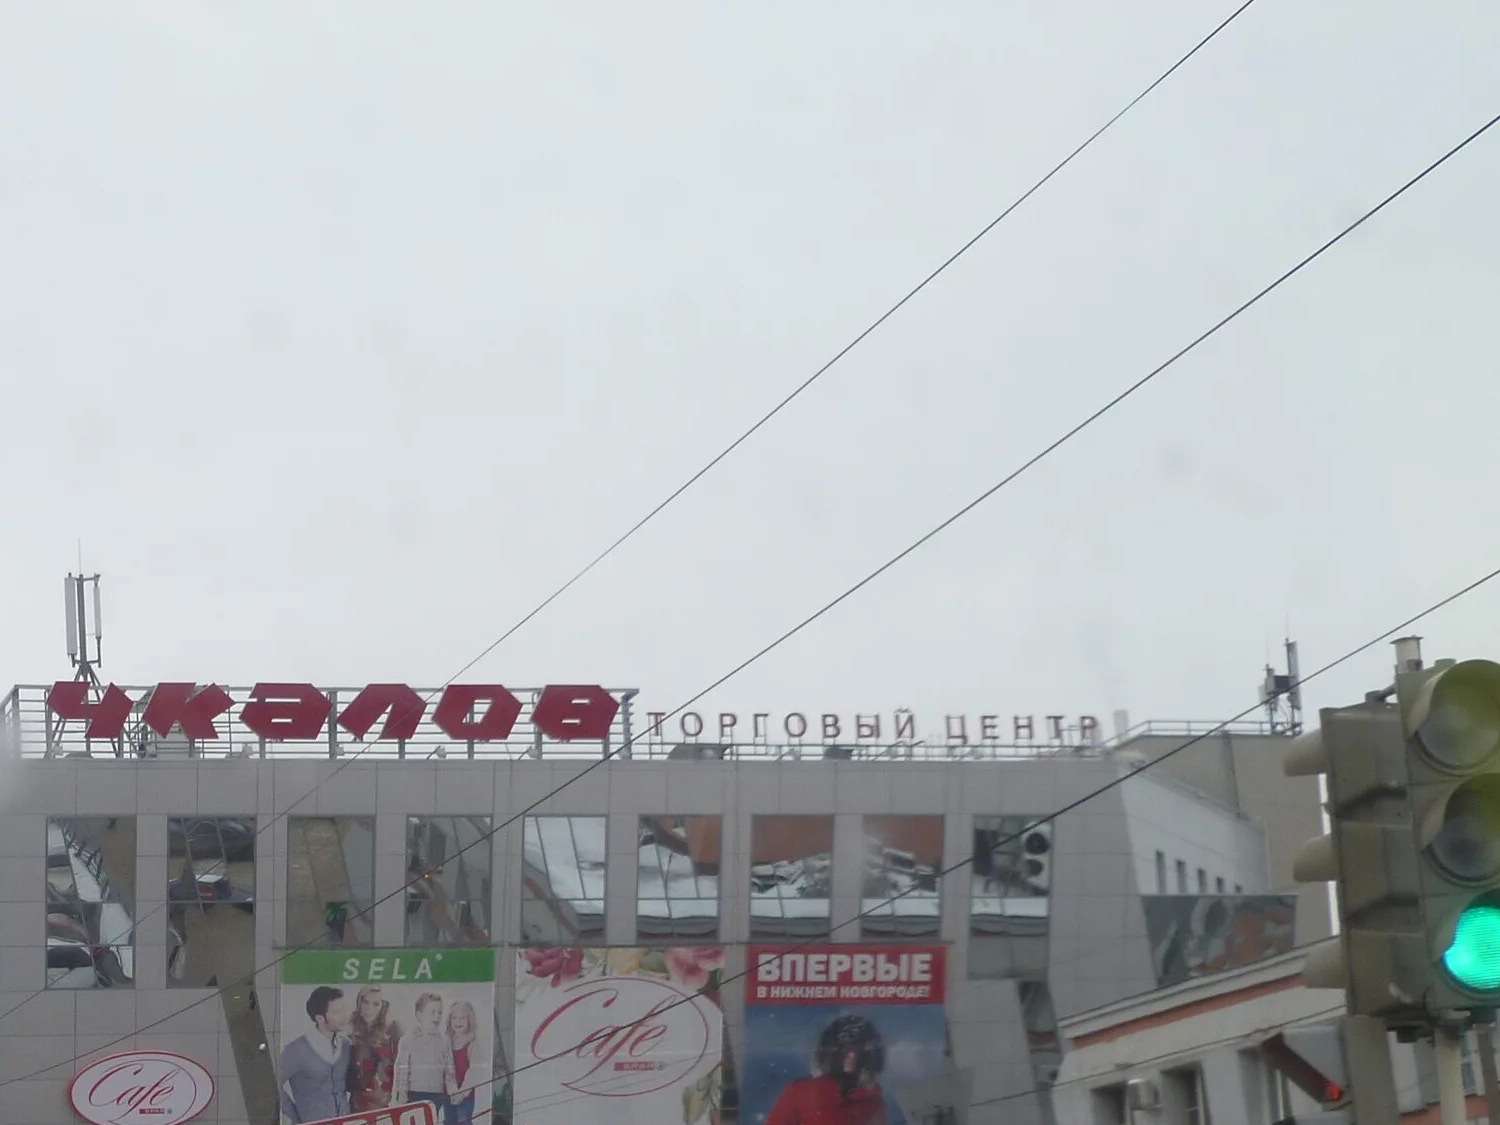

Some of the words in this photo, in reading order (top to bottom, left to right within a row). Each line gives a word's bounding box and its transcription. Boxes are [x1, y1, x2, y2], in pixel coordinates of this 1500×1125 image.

[646, 708, 915, 740] ТОРГОВЫЙ
[946, 714, 1099, 745] ЦЕНТР
[344, 956, 434, 981] SELA
[757, 952, 933, 983] ВПЕРВЫЕ
[770, 985, 835, 999] НИЖНЕМ
